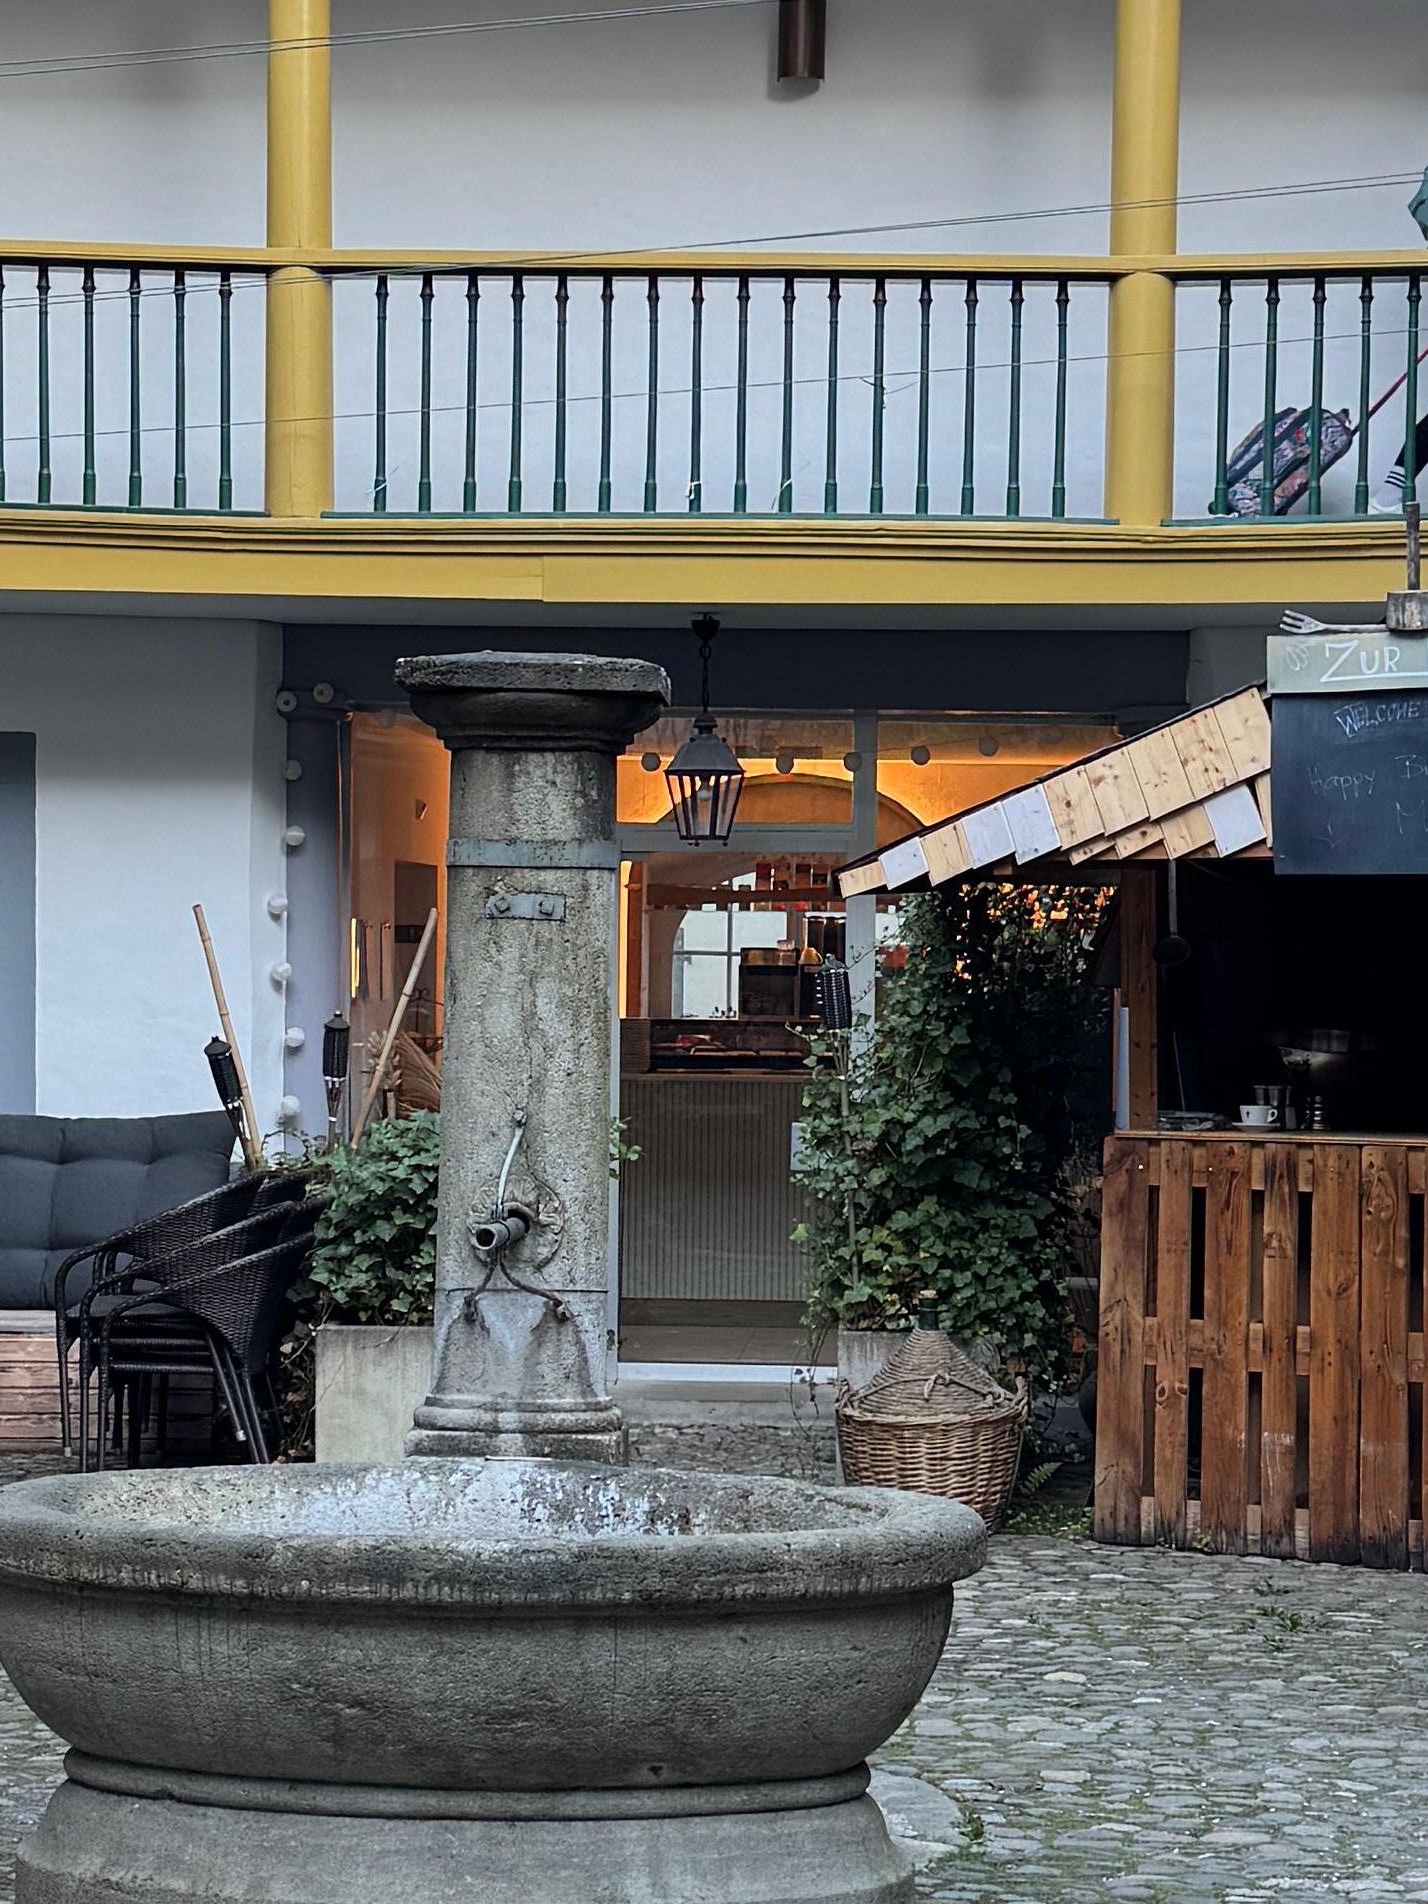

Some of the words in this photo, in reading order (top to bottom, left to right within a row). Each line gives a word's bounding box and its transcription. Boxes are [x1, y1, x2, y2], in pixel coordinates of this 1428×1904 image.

[1321, 639, 1400, 681] ZUR
[1336, 700, 1420, 737] WELCOME
[1308, 763, 1376, 800] Happy
